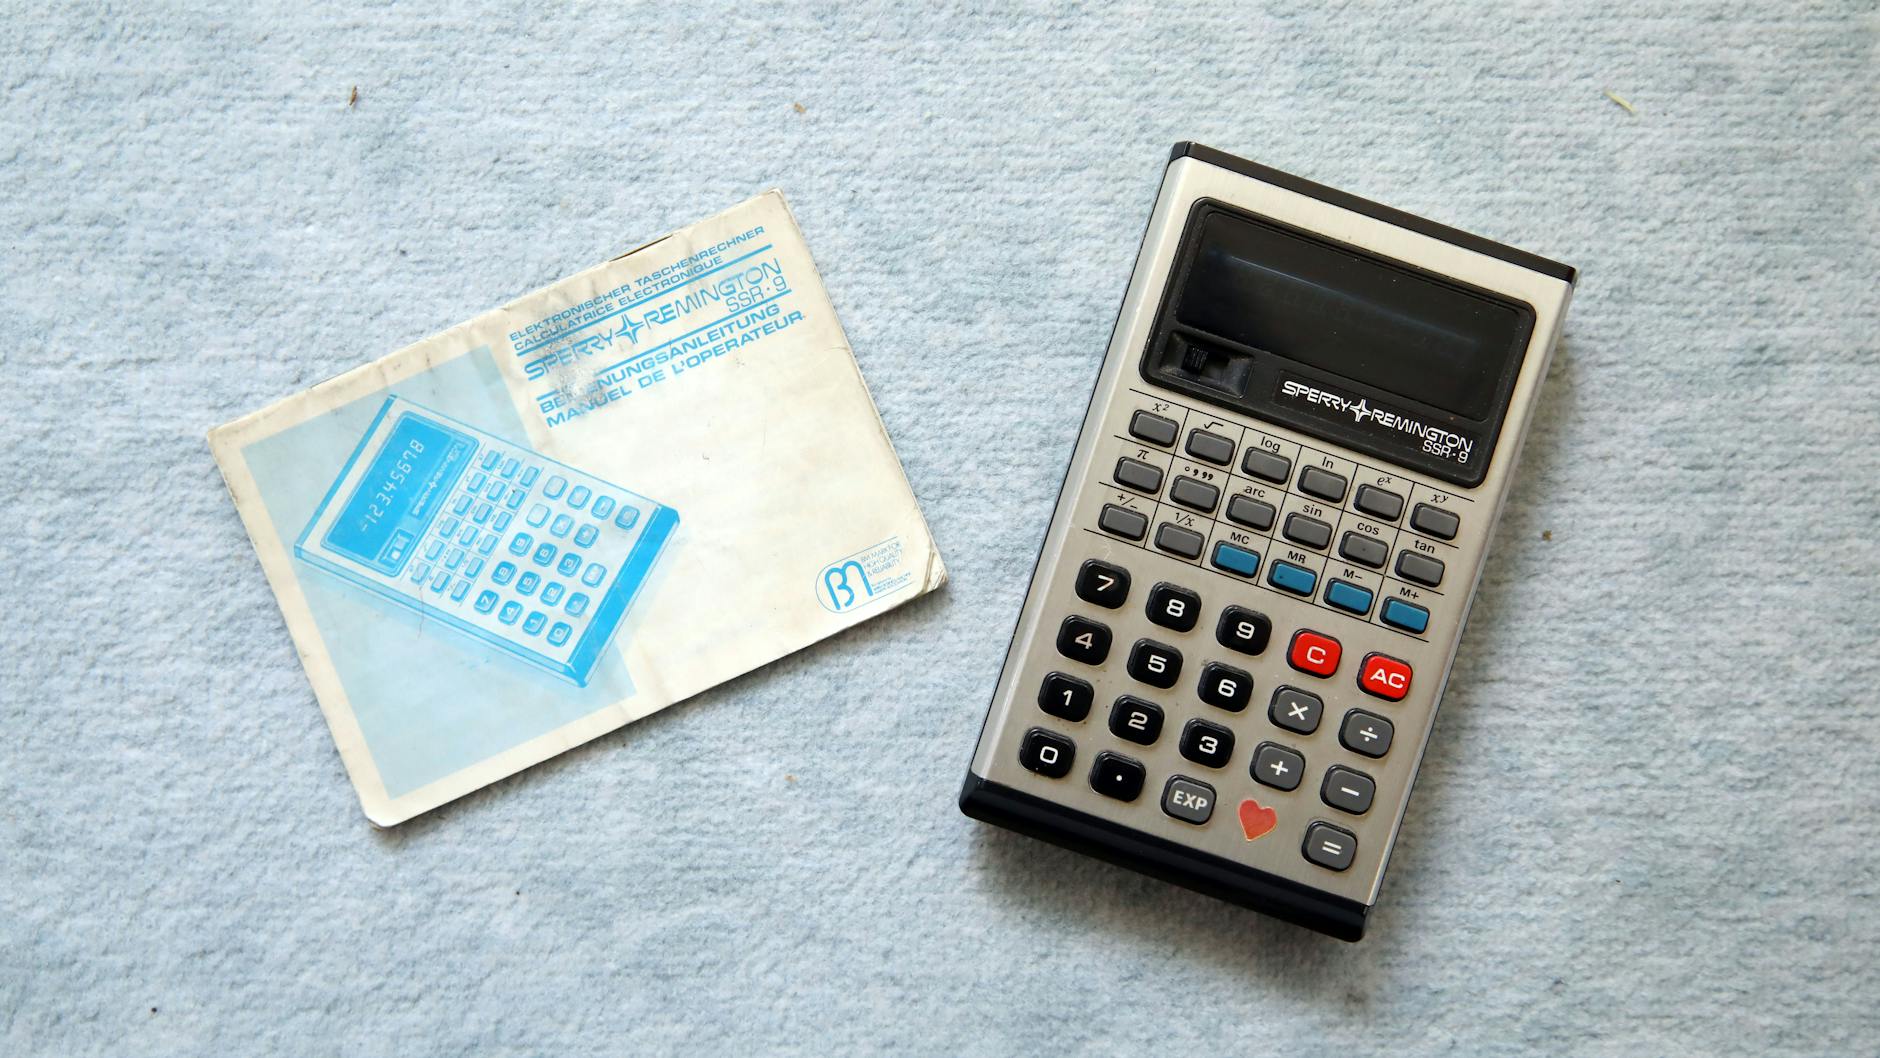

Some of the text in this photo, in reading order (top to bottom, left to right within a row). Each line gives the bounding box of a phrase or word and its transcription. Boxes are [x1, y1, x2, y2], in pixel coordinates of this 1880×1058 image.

[510, 225, 766, 341] ELEKTRONISCHER TASCHENRECHNER
[513, 255, 723, 351] CALCULATRICE ELECTRONIQUE
[524, 257, 782, 381] SPERRY REMINGTON
[546, 386, 632, 428] MANUEL
[638, 369, 666, 389] DE
[1281, 380, 1474, 453] SPERRY REMINGTON
[1260, 436, 1281, 454] log
[1243, 486, 1266, 498] arc
[1302, 504, 1322, 517] sin
[1230, 531, 1250, 545] MC
[1357, 522, 1380, 535] cos
[1414, 540, 1435, 554] tan
[1287, 550, 1307, 564] MR
[1096, 574, 1115, 592] 7
[1399, 587, 1419, 600] M+
[1166, 599, 1186, 618] 8
[1235, 621, 1256, 640] 9
[1074, 632, 1093, 650] 4
[1147, 654, 1168, 674] 5
[1306, 646, 1327, 665] C
[1217, 678, 1237, 698] 6
[1370, 668, 1406, 689] AC
[1062, 689, 1073, 707] 1
[1128, 711, 1148, 731] 2
[1198, 735, 1219, 755] 3
[1172, 790, 1208, 812] EXP
